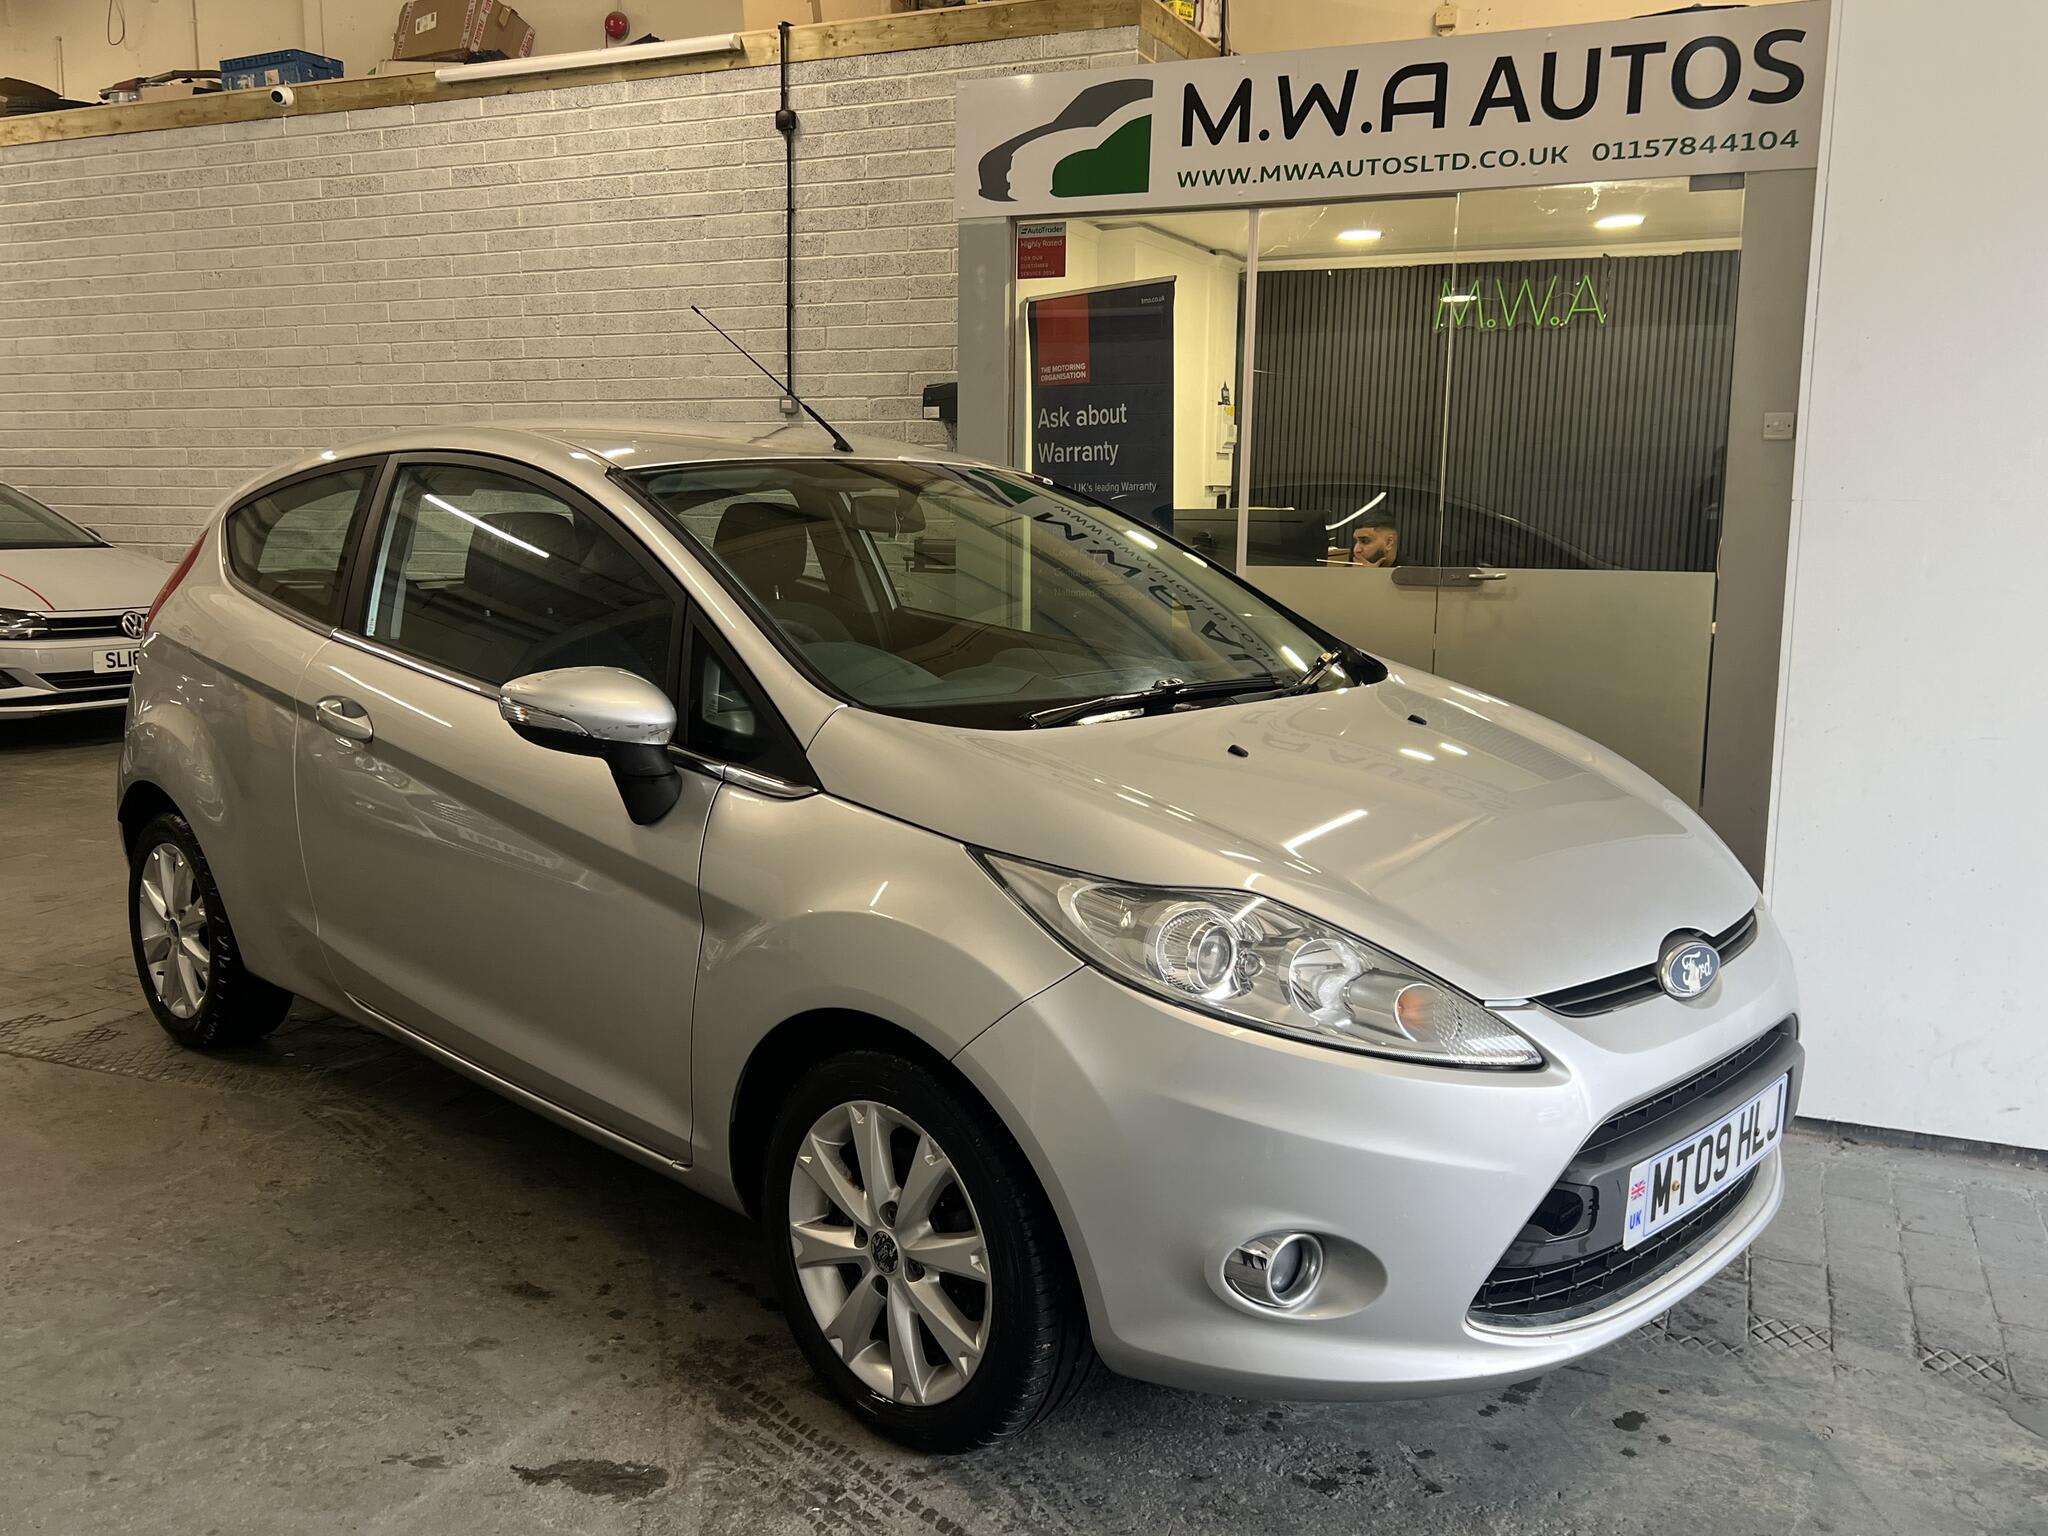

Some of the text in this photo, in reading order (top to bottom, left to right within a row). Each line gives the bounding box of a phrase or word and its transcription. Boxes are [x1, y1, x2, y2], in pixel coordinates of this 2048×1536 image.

[1181, 29, 1807, 147] M.W.A AUTOS
[1177, 129, 1800, 188] WWW.MWAAUTOSLTD.CO.UK 01157844104
[1435, 275, 1605, 331] M.W.A
[1040, 371, 1087, 382] ORGANISATION
[1041, 362, 1086, 374] THE MOTORING
[1038, 403, 1127, 428] Ask about
[1038, 441, 1119, 466] Warranty
[1095, 483, 1119, 493] leading
[1121, 481, 1157, 493] Warranty
[1650, 1083, 1783, 1223] MT09 HLJ
[1629, 1210, 1642, 1230] UK
